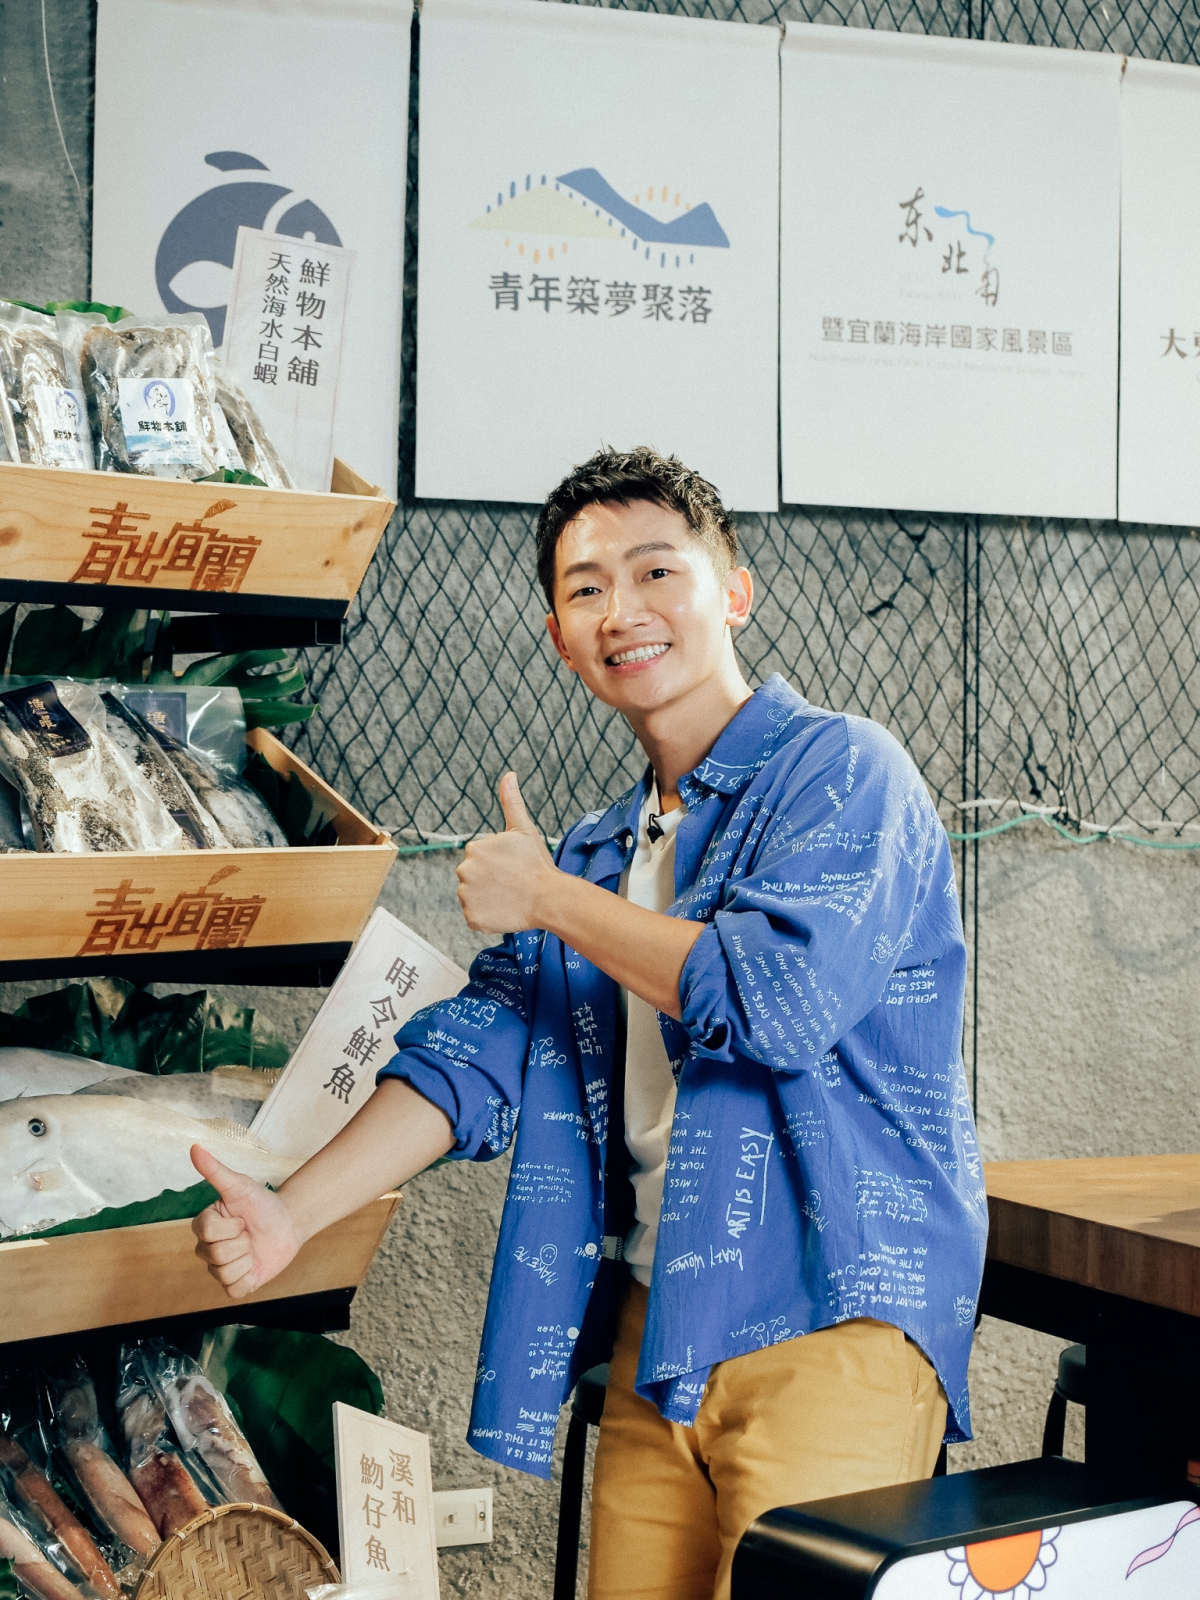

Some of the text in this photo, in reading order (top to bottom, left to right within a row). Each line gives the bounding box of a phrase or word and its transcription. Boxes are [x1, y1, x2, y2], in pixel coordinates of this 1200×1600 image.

[489, 271, 713, 324] 青年築夢聚落
[253, 252, 291, 386] 天然海水白蝦
[287, 258, 331, 386] 鮮物本舖
[821, 316, 1074, 356] 暨宜蘭海岸國家風景區
[1159, 327, 1200, 359] 大
[820, 871, 865, 883] NOTHING
[825, 900, 845, 913] BOY
[732, 935, 746, 959] SMILE
[775, 952, 788, 970] AND
[794, 956, 808, 969] ME
[741, 961, 757, 987] YOUR
[807, 968, 817, 989] MISS
[912, 970, 935, 978] DAYS
[772, 981, 783, 993] TO
[784, 973, 804, 998] MOVED
[889, 982, 907, 992] BUT
[776, 996, 793, 1016] NEXT
[816, 990, 825, 1005] YOU
[886, 992, 938, 1005] WEIRD BOY
[800, 1000, 813, 1016] YOU
[323, 956, 419, 1104] 時令鮮魚
[771, 1018, 787, 1039] YOUR
[791, 1018, 807, 1037] FEET
[809, 1018, 821, 1032] WAY
[882, 1063, 950, 1083] YOU MISS ME
[890, 1083, 947, 1101] YOU MOVED
[543, 1111, 574, 1122] SUMMER
[695, 1129, 712, 1137] THE
[882, 1127, 900, 1138] YOU
[922, 1124, 947, 1135] YOUR
[690, 1146, 707, 1154] THE
[680, 1162, 704, 1170] YOUR
[670, 1179, 691, 1187] MISS
[726, 1127, 773, 1239] ART IS EASY
[680, 1195, 699, 1203] BUT
[513, 1246, 558, 1287] MAKE ME
[389, 1448, 416, 1525] 溪和
[360, 1453, 391, 1572] 魩仔魚
